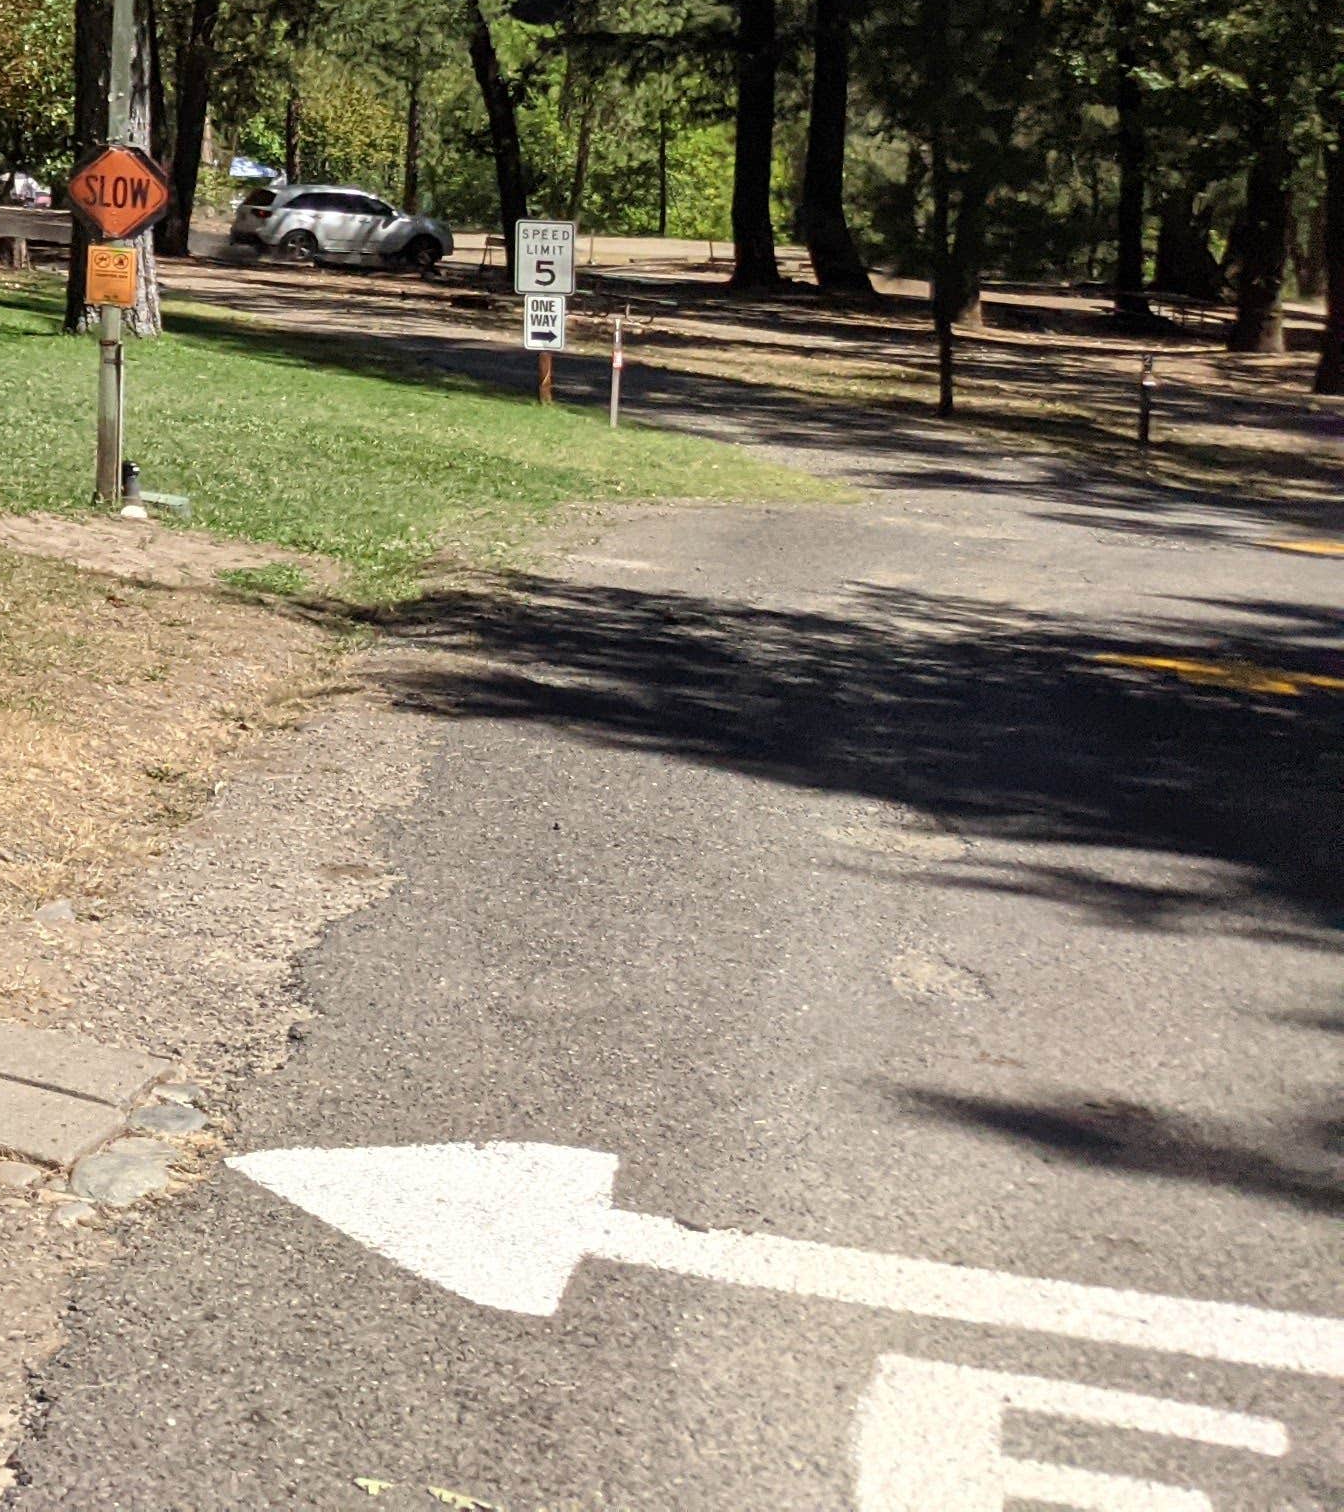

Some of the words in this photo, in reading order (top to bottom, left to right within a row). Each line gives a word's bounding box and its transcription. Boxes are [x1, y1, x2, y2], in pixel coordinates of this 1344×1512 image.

[83, 175, 151, 209] SLOW
[522, 229, 570, 241] SPEED
[526, 245, 564, 256] LIMIT
[534, 260, 556, 286] 5
[531, 299, 556, 313] ONE
[530, 314, 558, 328] WAY
